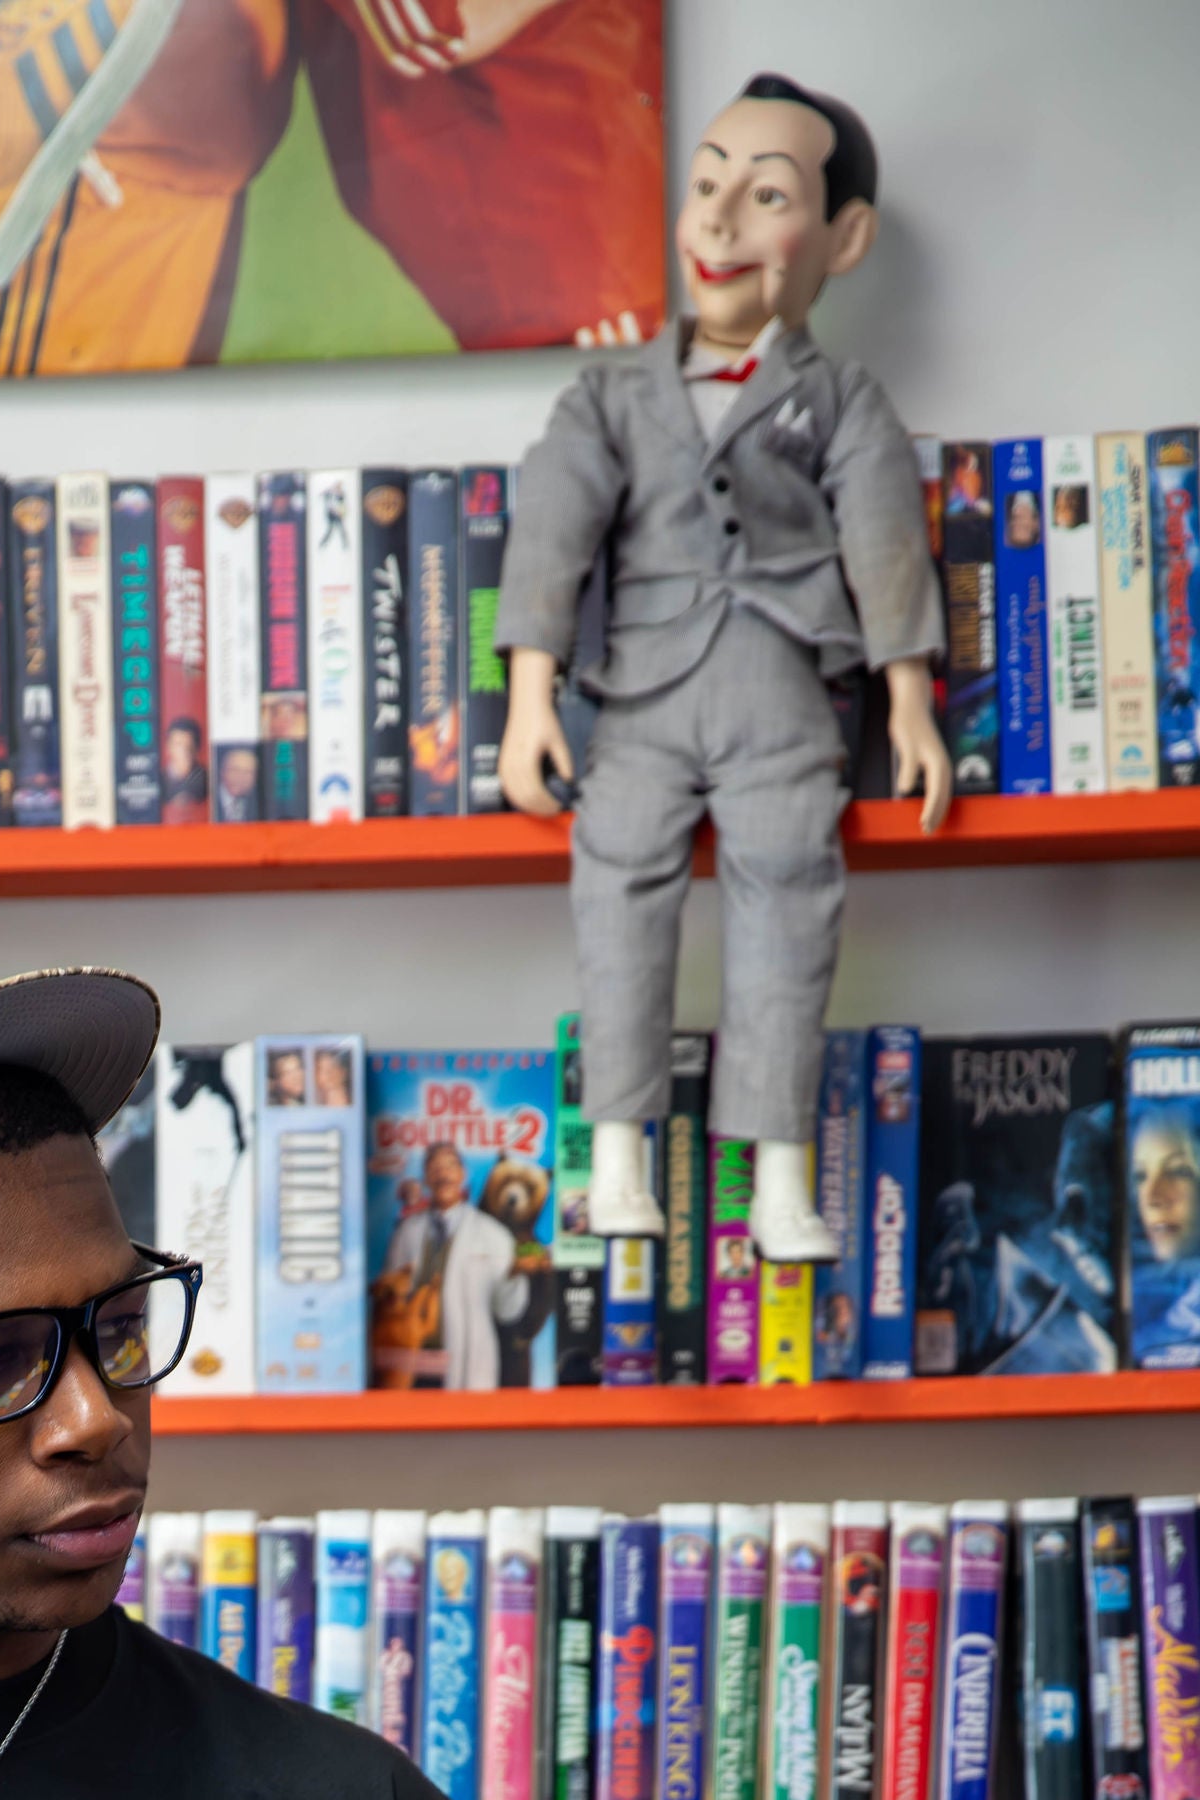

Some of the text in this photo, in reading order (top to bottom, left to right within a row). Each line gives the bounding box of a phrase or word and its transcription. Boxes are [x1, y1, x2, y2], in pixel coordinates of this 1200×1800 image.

[120, 544, 150, 747] TIMECOP
[373, 554, 402, 731] TWISTER
[1067, 595, 1097, 710] INSTINCT
[423, 1082, 484, 1118] DR.
[952, 1048, 1076, 1084] FREDDY
[372, 1117, 509, 1150] DOLITTLE
[511, 1111, 542, 1152] 2
[869, 1175, 904, 1317] ROBOCOP
[429, 1610, 472, 1715] Peter
[611, 1625, 654, 1799] PINOCCHIO
[666, 1645, 696, 1800] LION KING
[721, 1614, 747, 1716] WINNIE
[952, 1633, 996, 1783] CINDERELLA
[1151, 1606, 1198, 1772] Aladdin
[835, 1684, 872, 1788] MULAN
